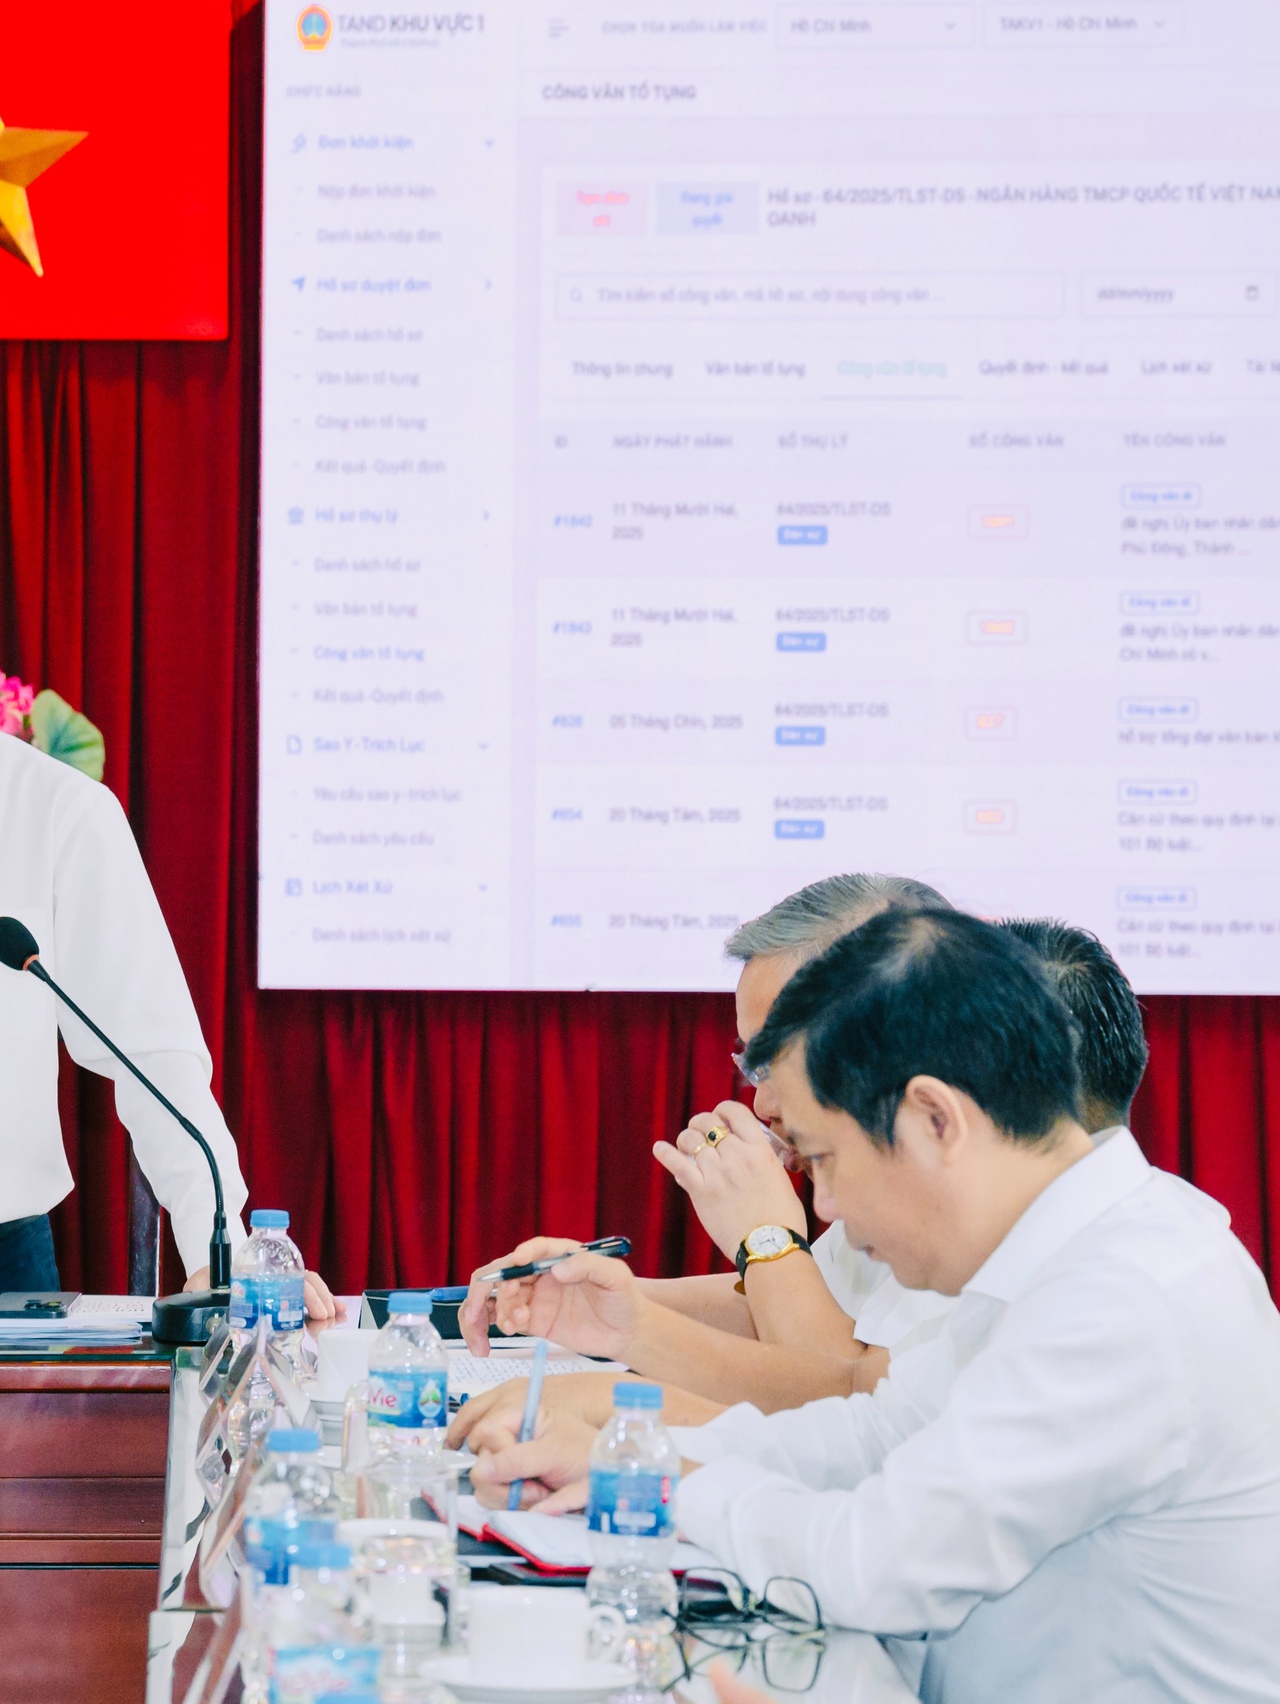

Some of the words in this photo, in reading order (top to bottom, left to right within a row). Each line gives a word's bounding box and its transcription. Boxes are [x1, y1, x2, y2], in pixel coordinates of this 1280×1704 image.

[337, 15, 386, 32] TAND
[391, 16, 428, 31] KHU
[434, 13, 471, 35] VỰC
[478, 14, 485, 32] 1
[542, 83, 588, 100] CÔNG
[593, 82, 624, 99] VĂN
[630, 80, 649, 100] TỐ
[654, 84, 697, 102] TỤNG
